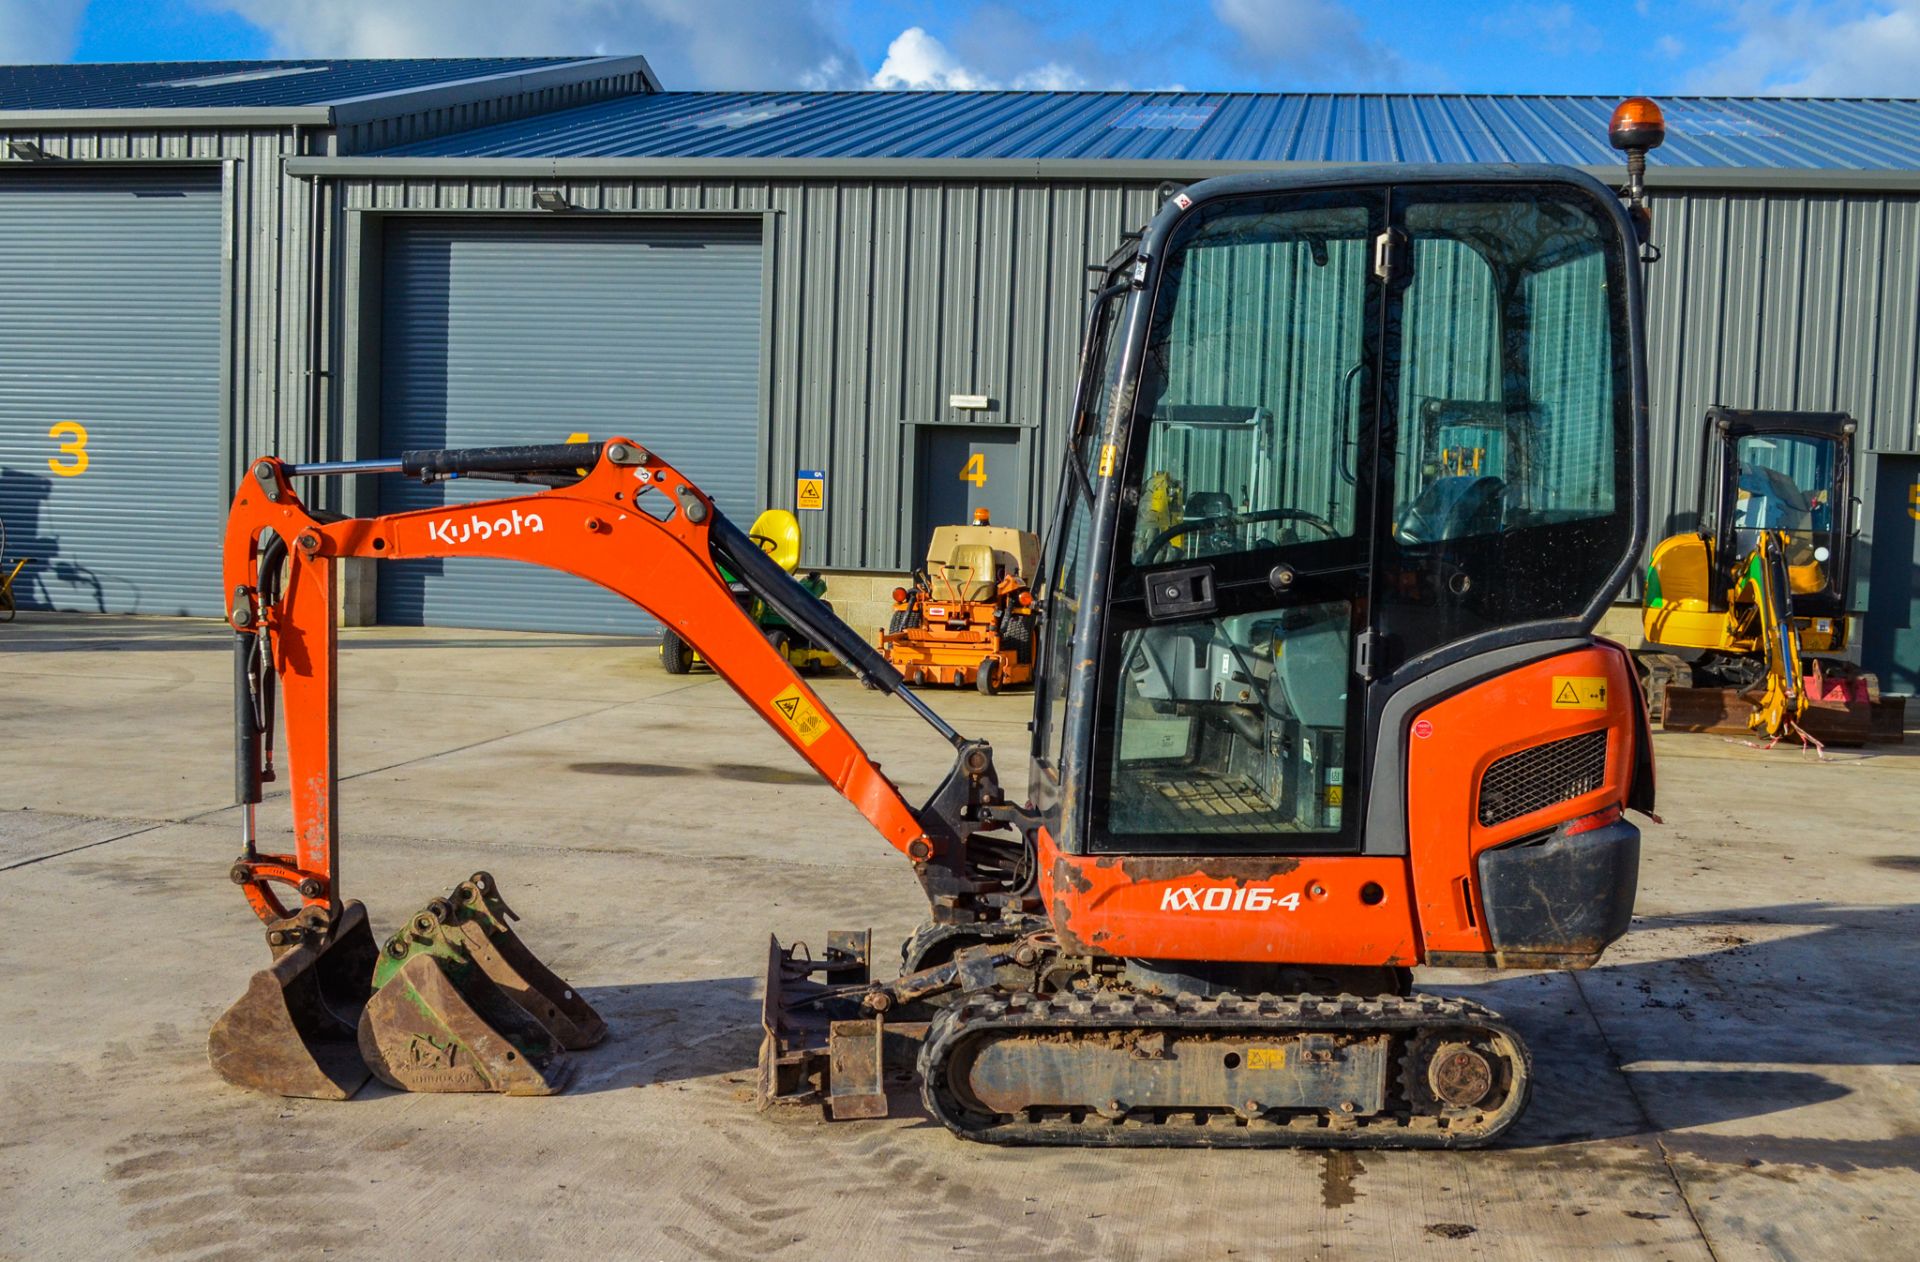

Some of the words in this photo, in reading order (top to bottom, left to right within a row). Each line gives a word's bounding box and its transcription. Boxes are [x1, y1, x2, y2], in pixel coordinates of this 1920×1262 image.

[48, 421, 89, 477] 3
[959, 453, 987, 488] 4
[428, 509, 544, 545] Kubota
[1160, 887, 1300, 911] KX016-4
